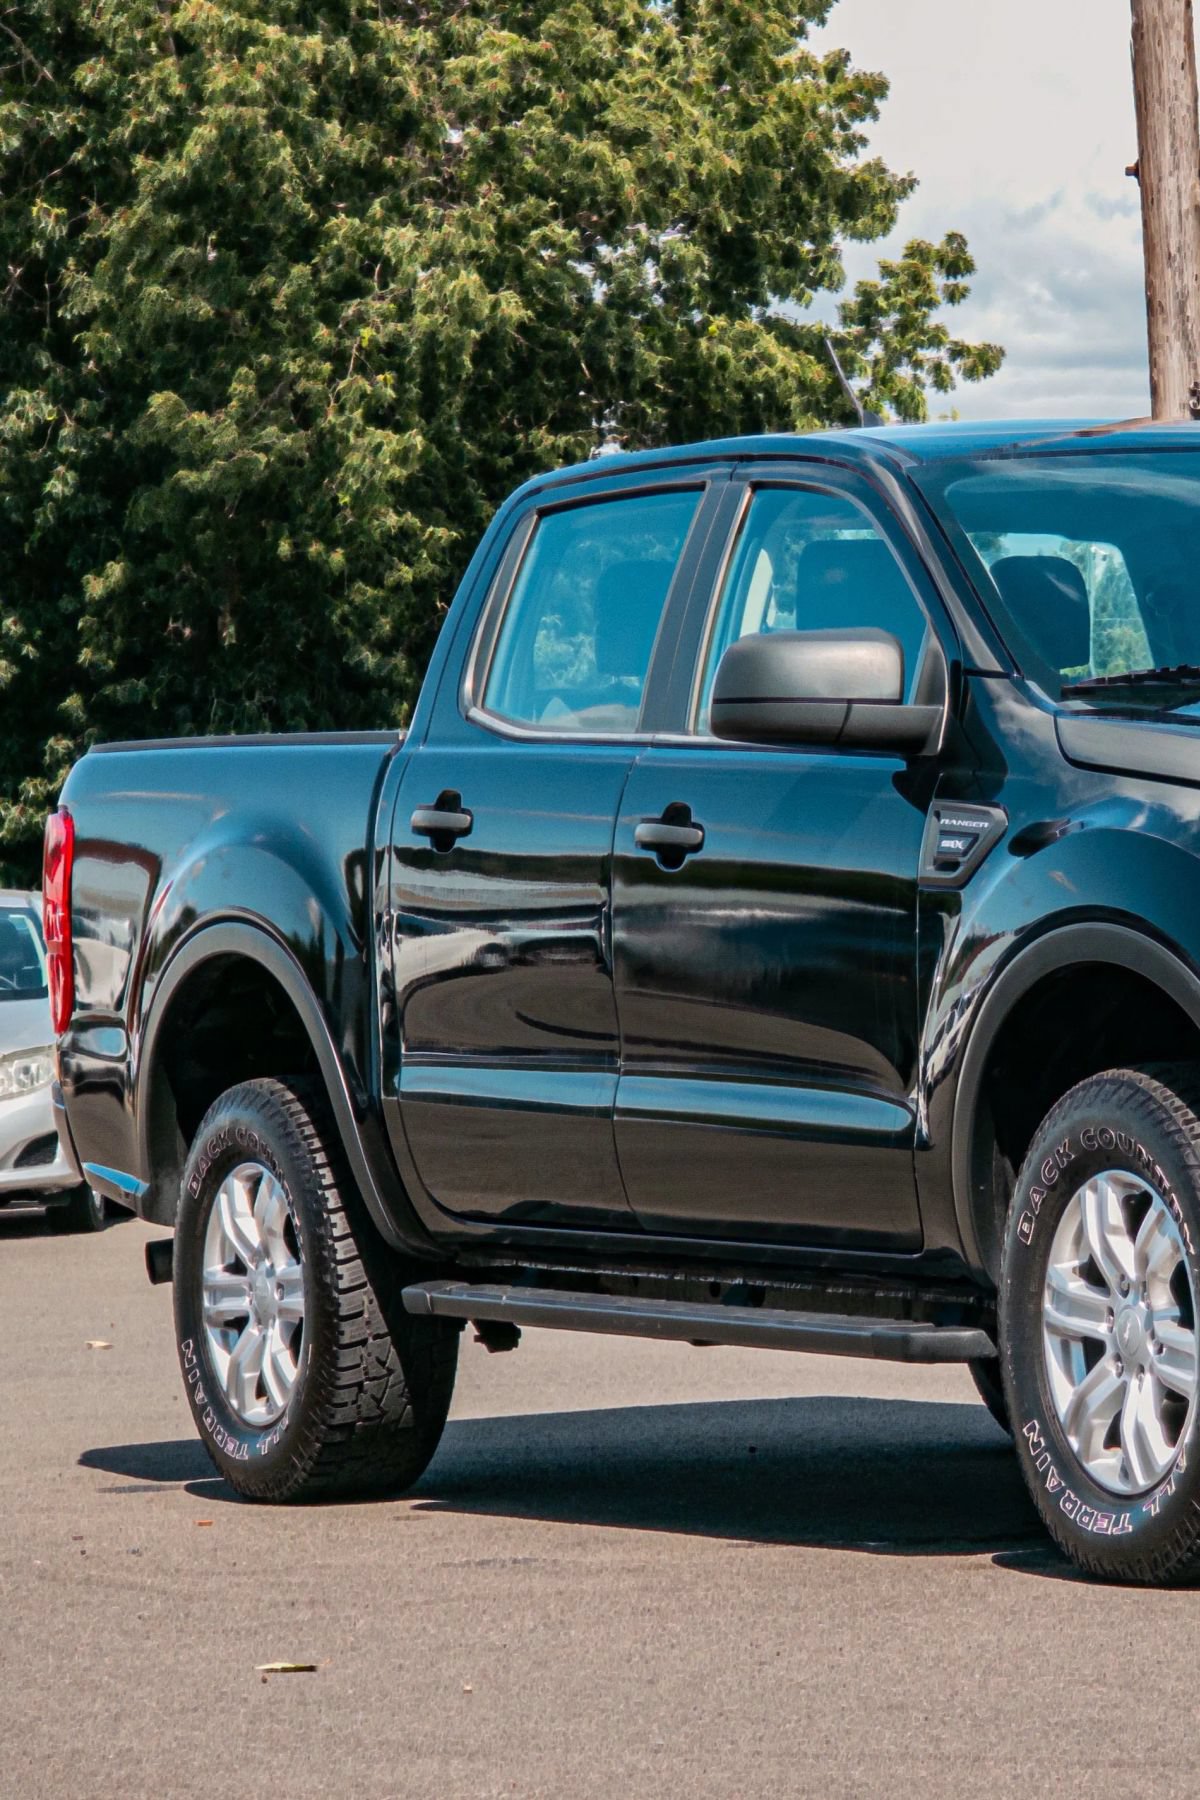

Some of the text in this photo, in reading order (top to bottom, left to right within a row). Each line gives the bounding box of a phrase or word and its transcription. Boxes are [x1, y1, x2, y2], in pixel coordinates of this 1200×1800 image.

[939, 818, 990, 828] RANGER
[186, 1126, 233, 1199] BACK
[1017, 1137, 1076, 1246] BACK
[181, 1339, 249, 1460] TERRAIN
[1022, 1418, 1133, 1536] TERRAIN
